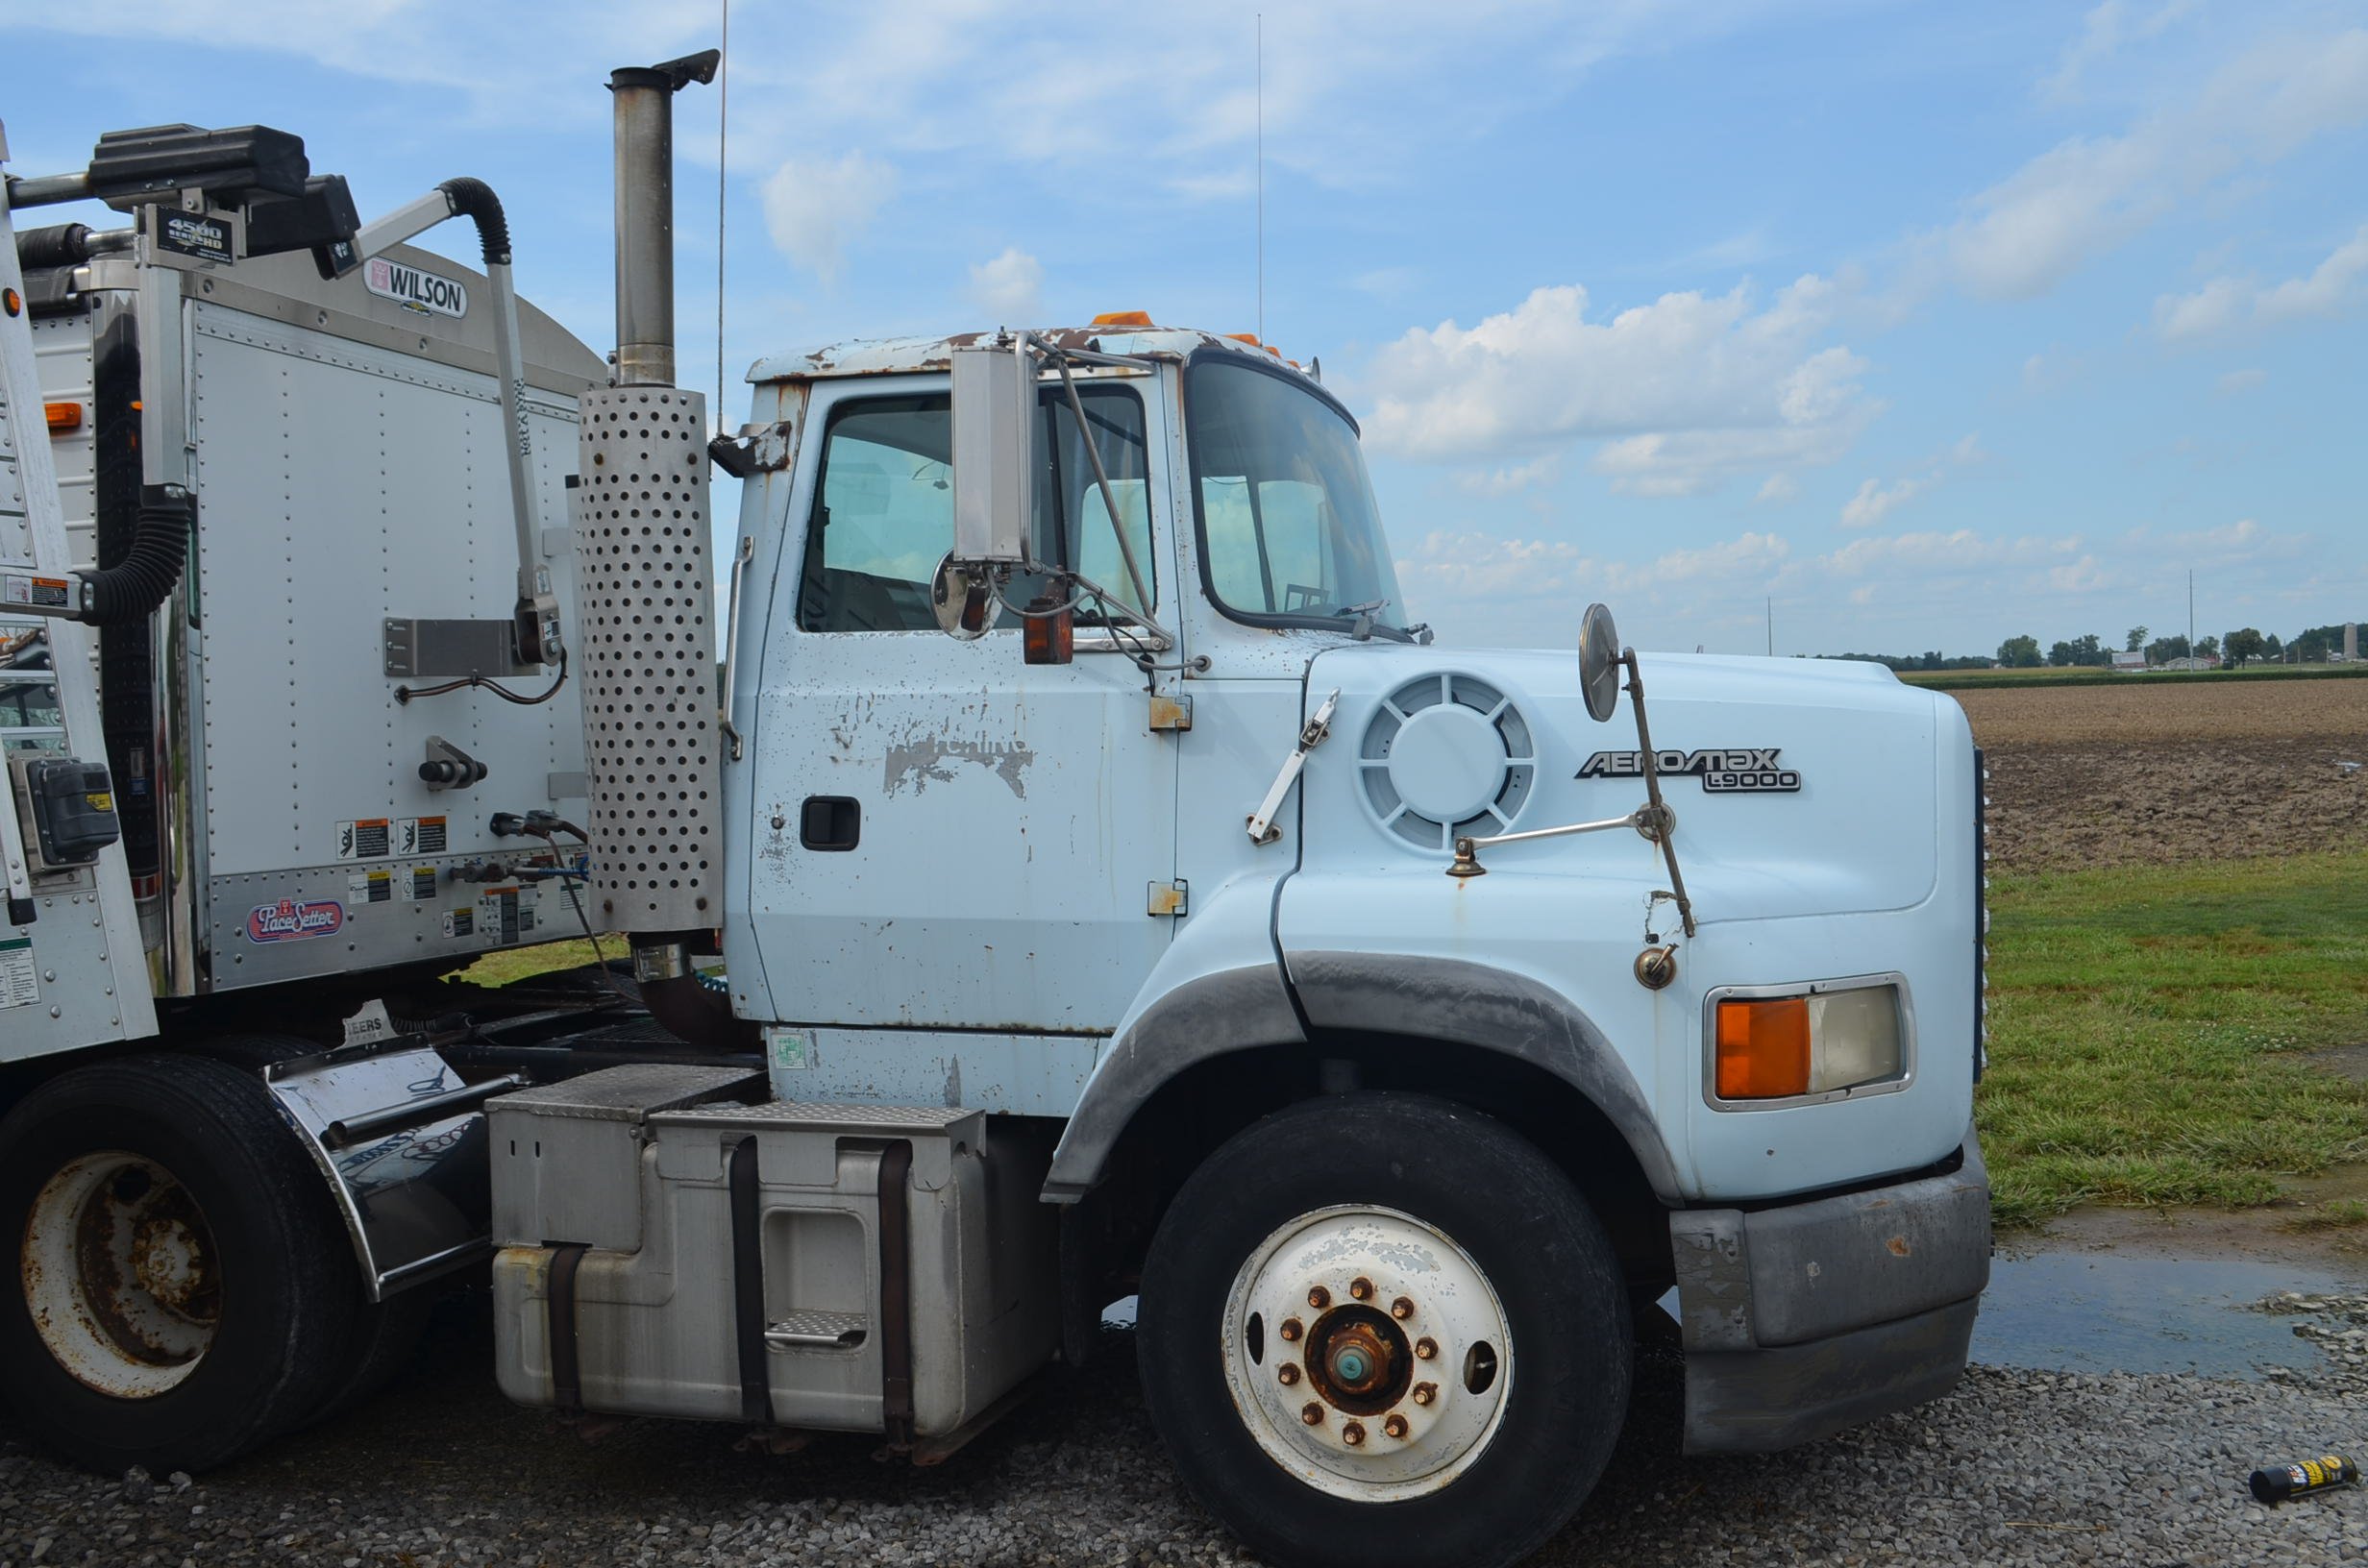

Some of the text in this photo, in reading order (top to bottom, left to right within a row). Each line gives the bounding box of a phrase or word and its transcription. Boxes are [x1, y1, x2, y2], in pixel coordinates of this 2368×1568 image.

[203, 237, 222, 249] HD
[389, 265, 461, 312] WILSON
[1707, 772, 1798, 789] L-9000
